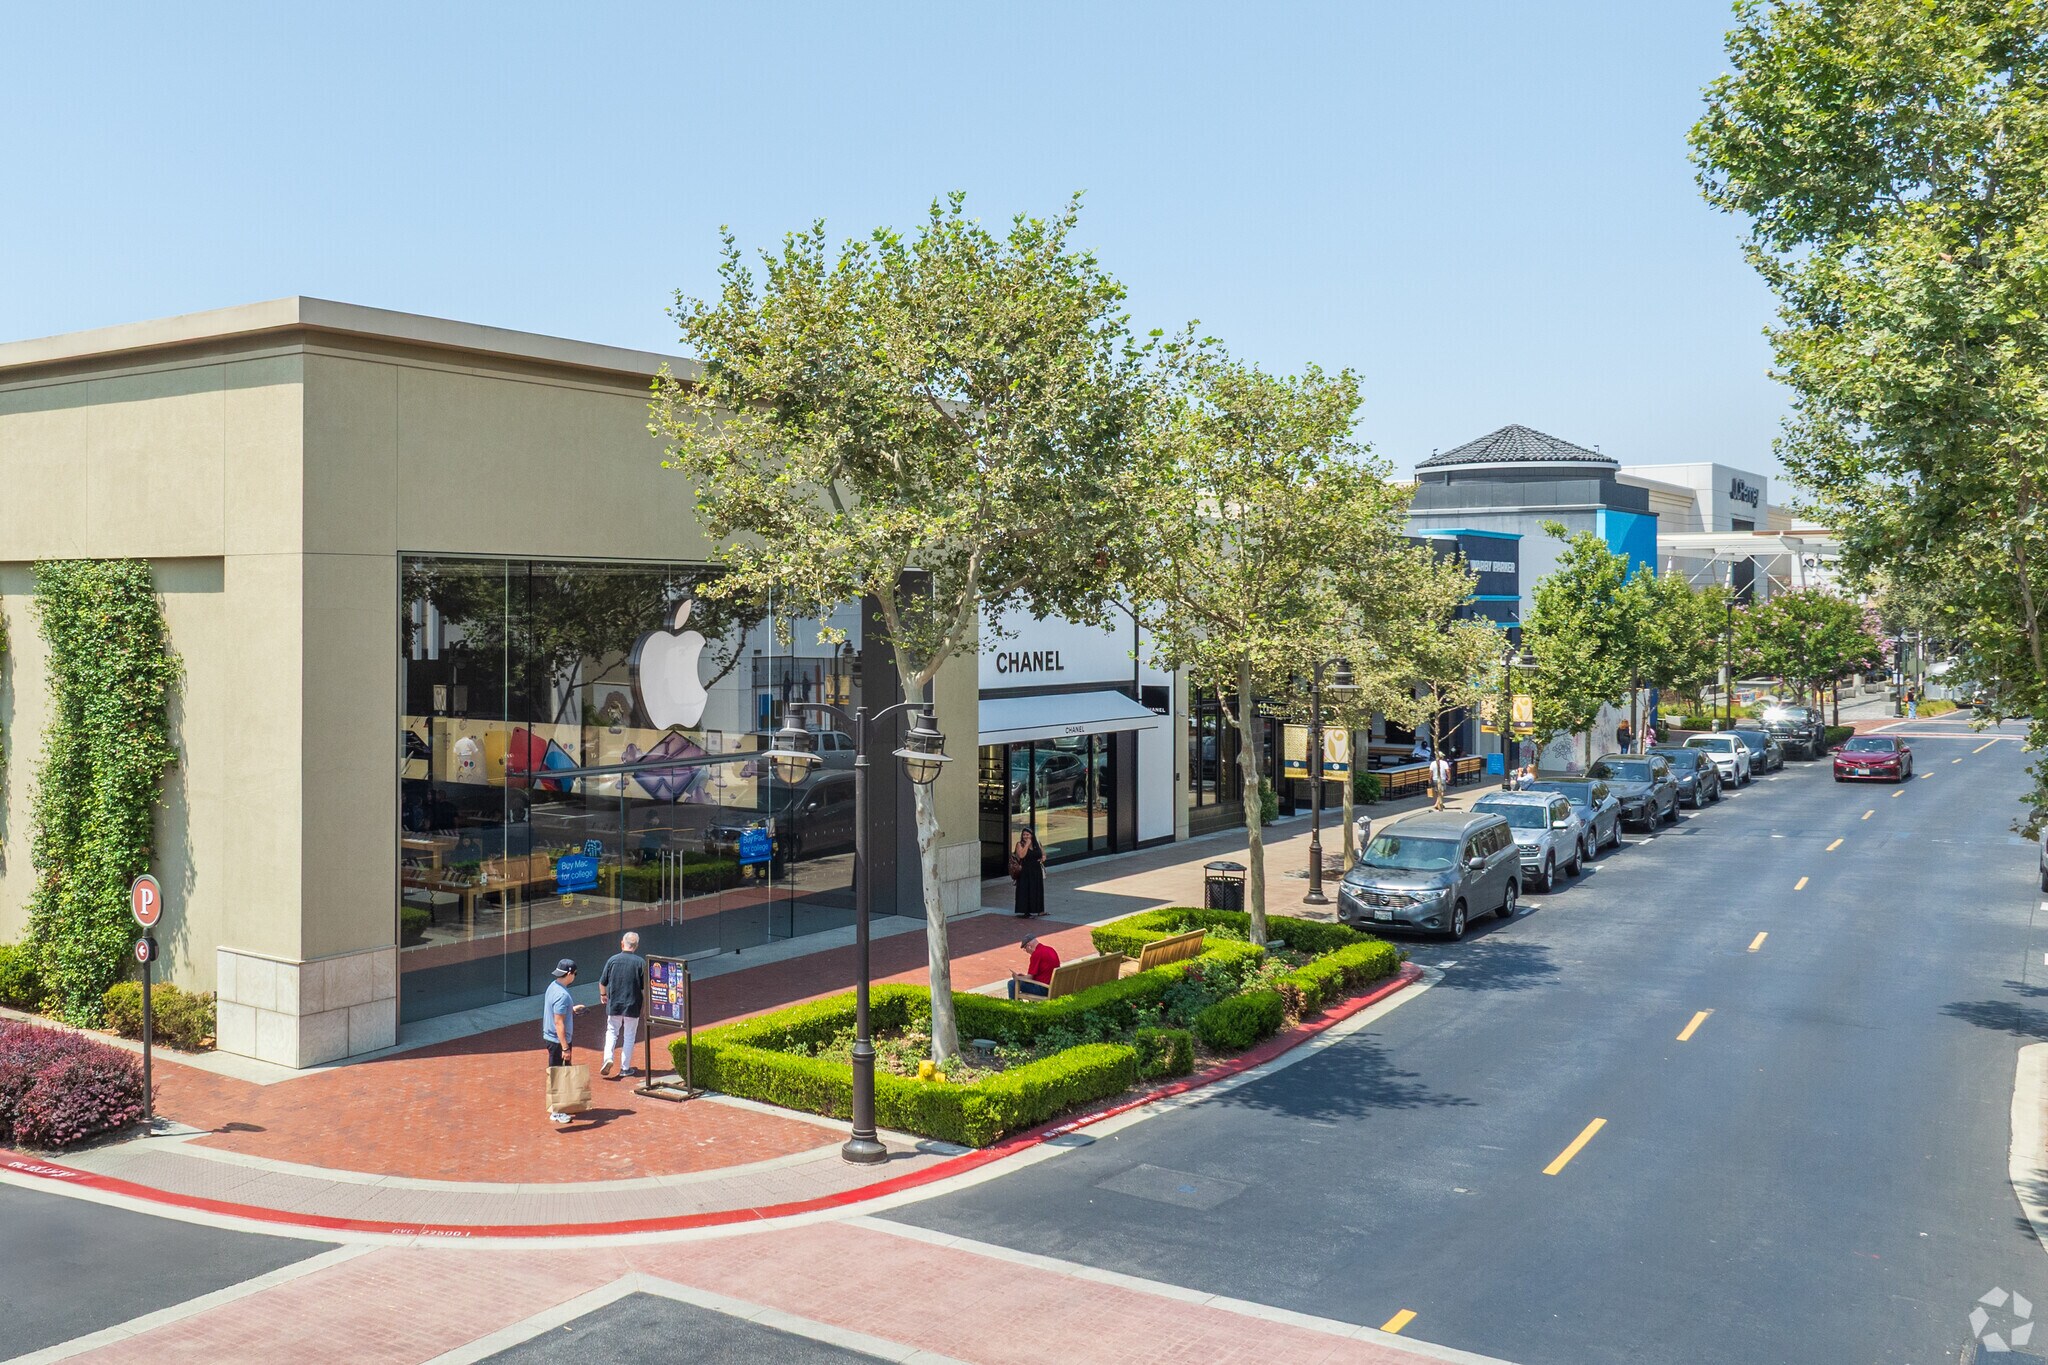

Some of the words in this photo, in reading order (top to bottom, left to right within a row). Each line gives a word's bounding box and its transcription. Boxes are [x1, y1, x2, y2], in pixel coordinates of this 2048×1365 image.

[1470, 560, 1492, 572] WARBY
[1492, 561, 1516, 573] PARKER
[996, 650, 1065, 674] CHANEL
[1065, 726, 1085, 734] CHANEL
[742, 835, 754, 844] Buy
[751, 844, 769, 852] college
[561, 862, 574, 870] Buy
[574, 860, 589, 868] Mac
[561, 872, 571, 881] for
[571, 870, 593, 879] college
[140, 888, 154, 915] P
